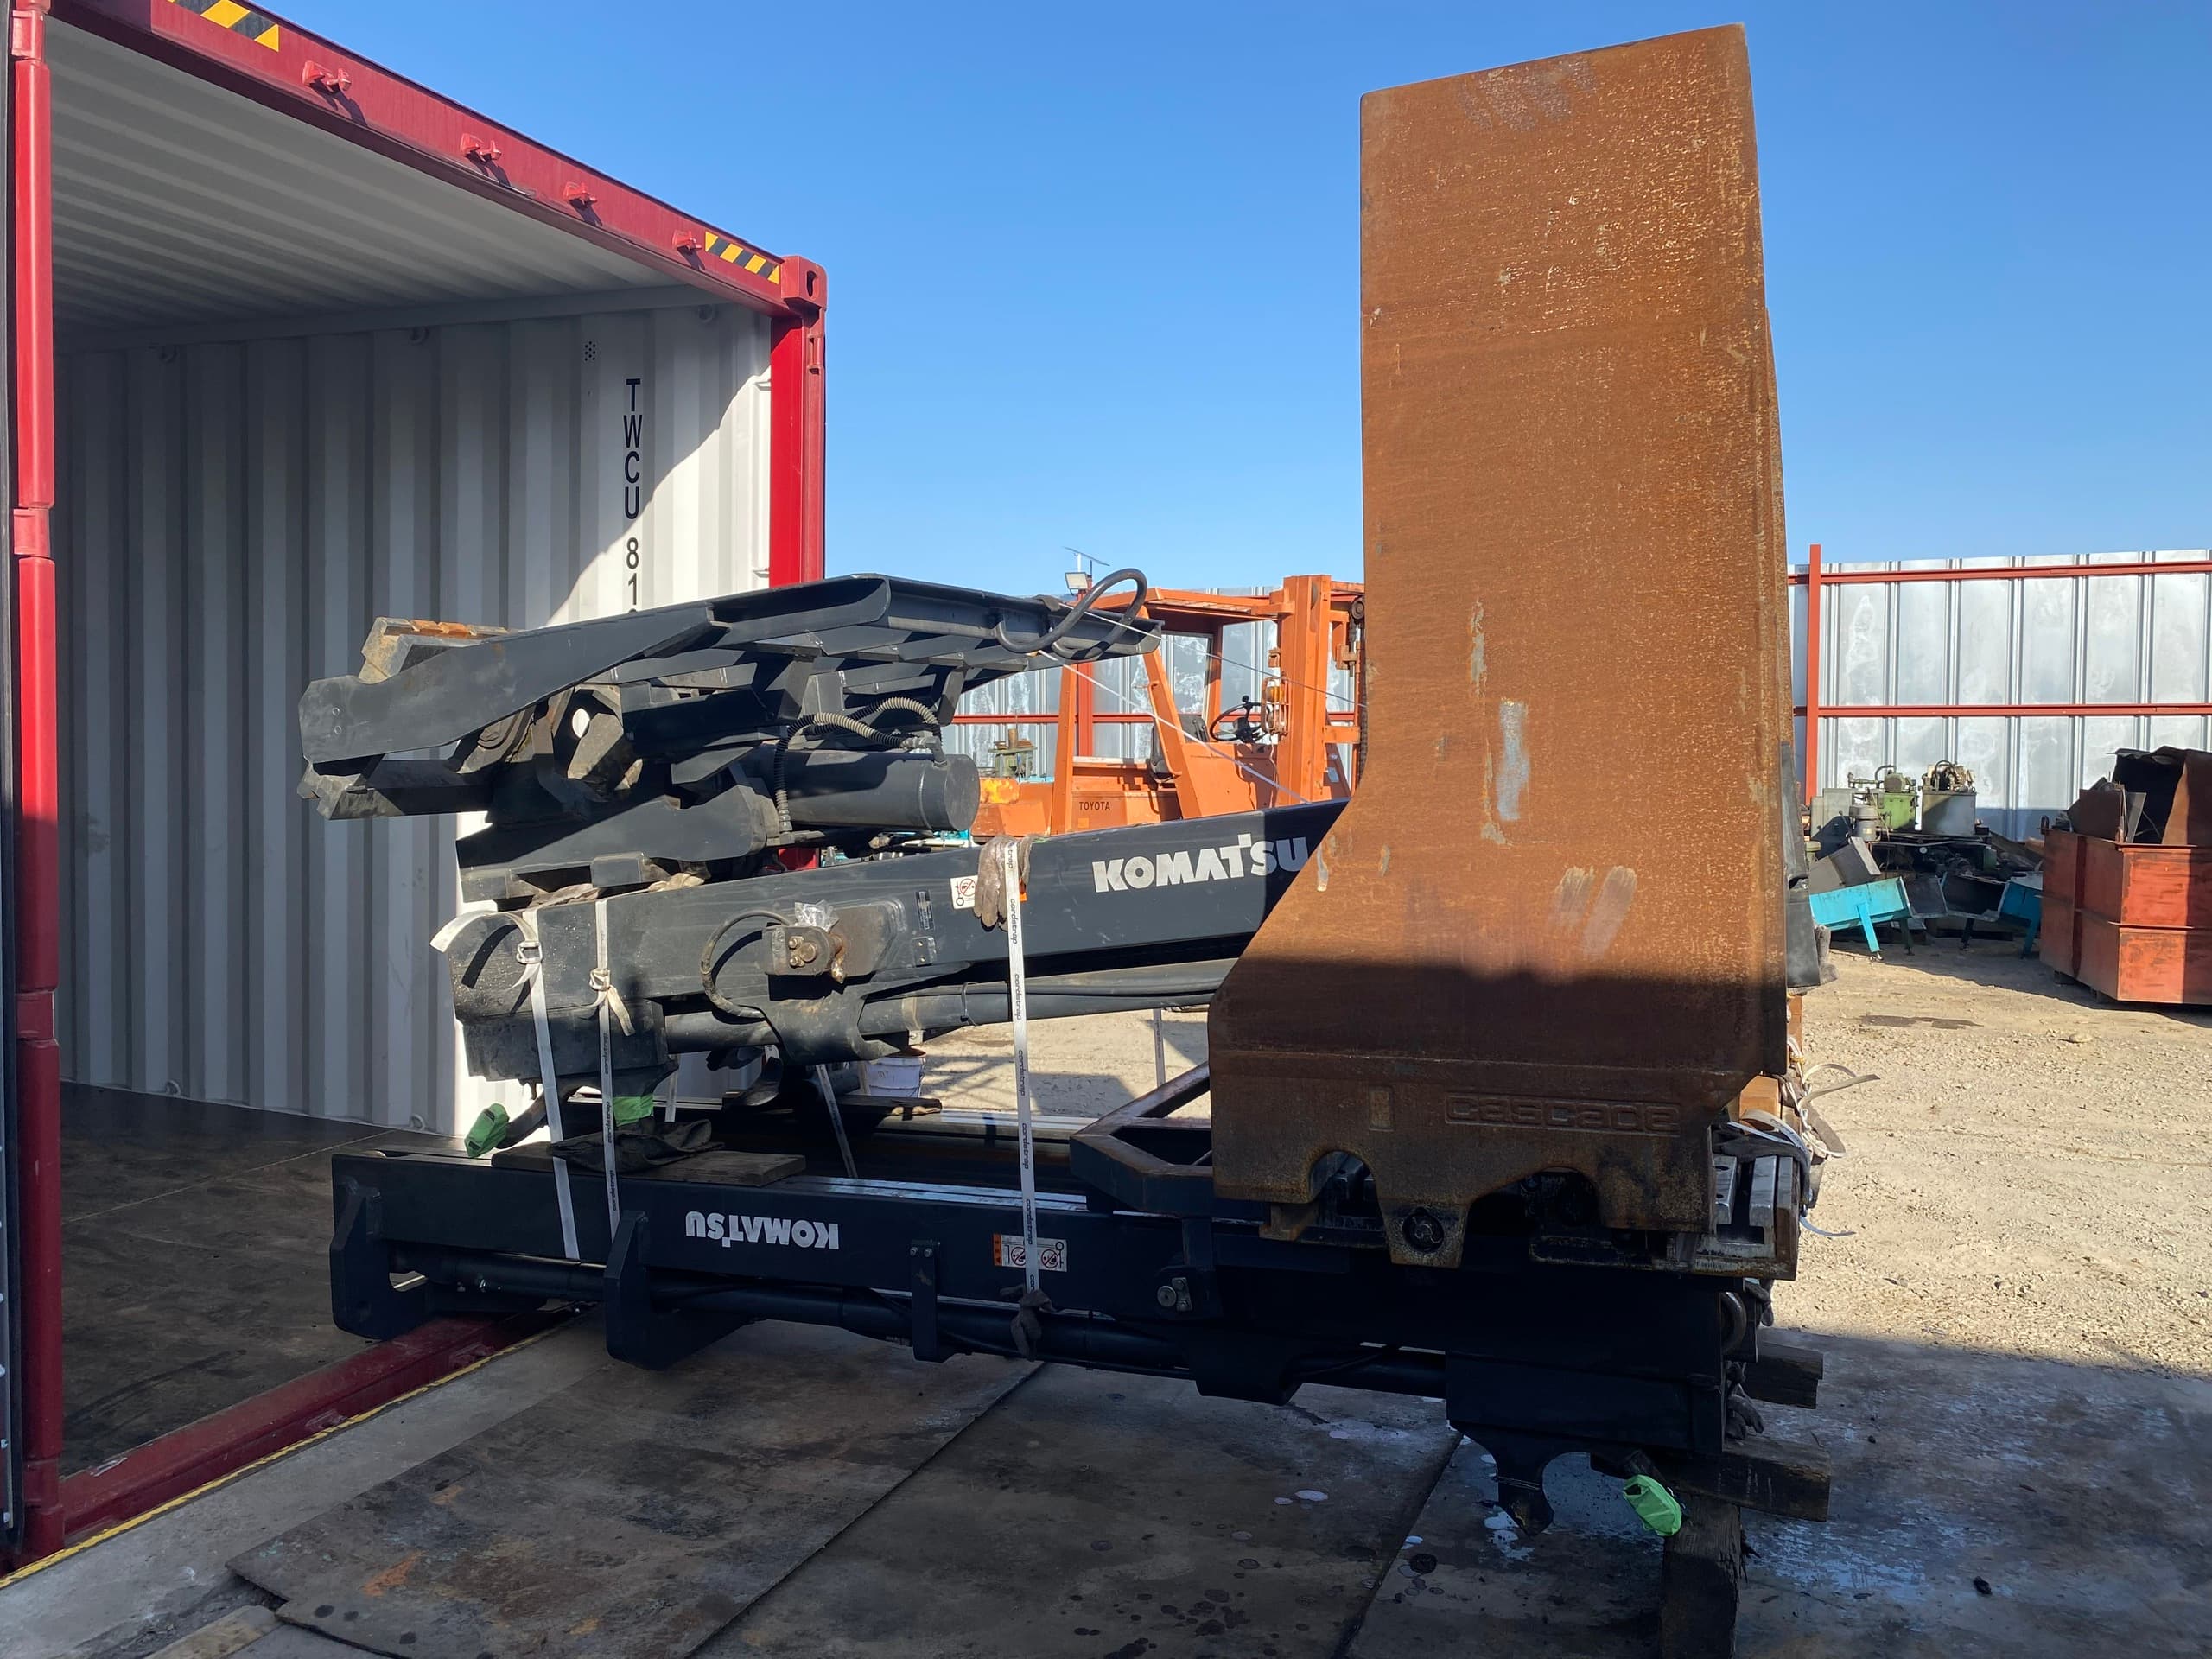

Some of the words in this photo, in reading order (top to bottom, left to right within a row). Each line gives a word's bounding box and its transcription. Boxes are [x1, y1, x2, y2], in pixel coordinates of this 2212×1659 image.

[623, 378, 643, 520] TWCU
[626, 537, 639, 614] 81
[1078, 801, 1111, 811] TOYOTA
[1091, 833, 1309, 893] KOMATSU
[1009, 898, 1019, 944] cordstrap
[1014, 973, 1023, 1020] cordstrap
[1019, 1049, 1027, 1096] cordstrap
[1021, 1122, 1031, 1170] cordstrap
[685, 1211, 840, 1249] KOMATSU
[1026, 1198, 1034, 1245] cordstrap
